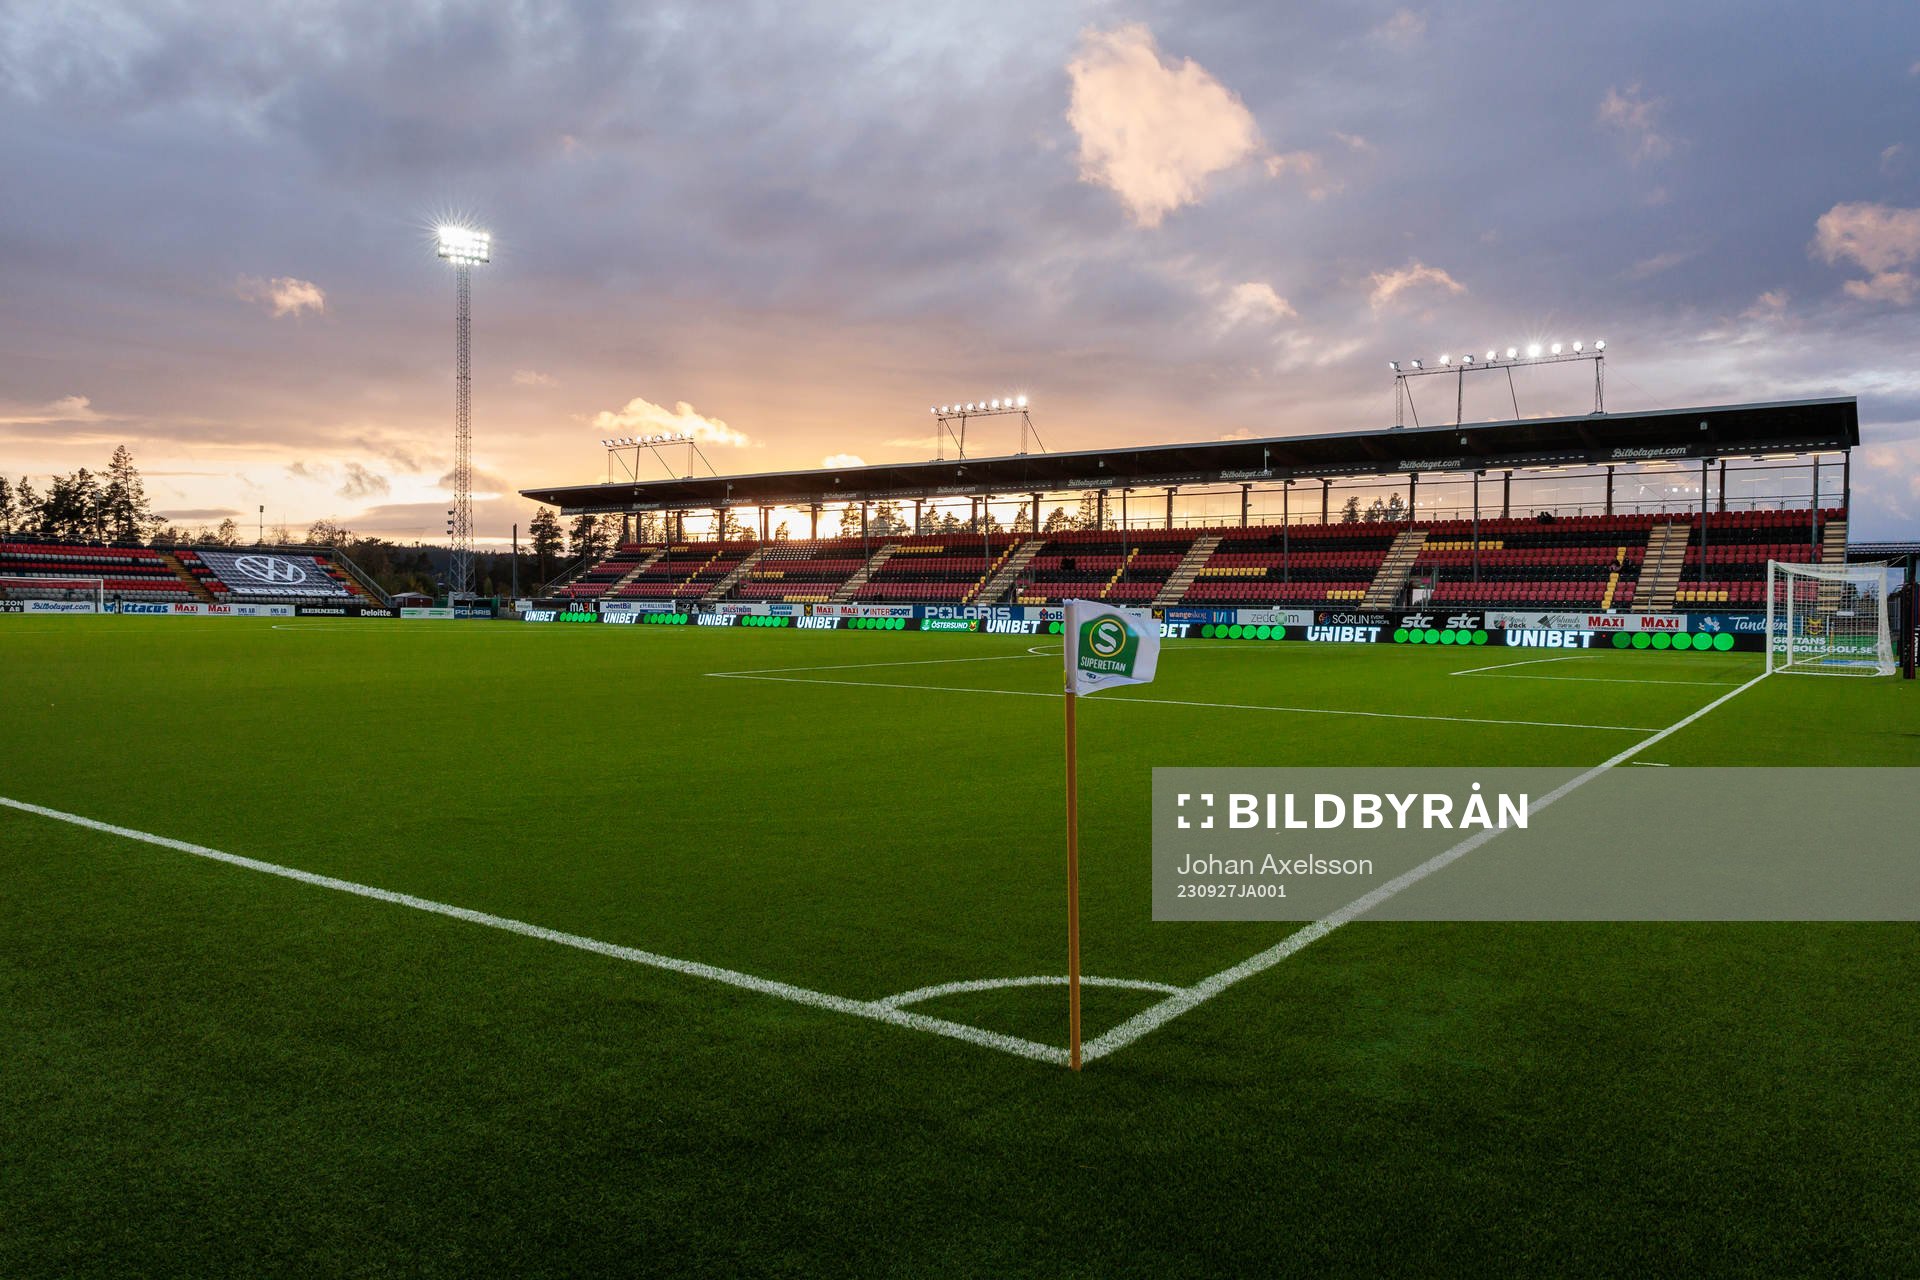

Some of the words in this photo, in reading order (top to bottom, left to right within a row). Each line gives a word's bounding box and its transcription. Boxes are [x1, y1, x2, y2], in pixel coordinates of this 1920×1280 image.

[1612, 447, 1687, 458] Bilbolaget.com
[1398, 460, 1461, 470] Bilbolaget.com
[32, 602, 91, 611] Bilbolaget.com
[869, 608, 911, 616] INTERSPORT
[525, 611, 556, 621] UNIBET
[603, 612, 639, 624] UNIBET
[925, 606, 1011, 620] POLARIS
[1332, 612, 1369, 624] SÖRLIN
[697, 614, 737, 626] UNIBET
[797, 616, 840, 629] UNIBET
[931, 620, 968, 630] ÖSTERSUND
[986, 619, 1041, 634] UNIBET
[1306, 625, 1381, 643] UNIBET
[1506, 630, 1595, 648] UNIBET
[1772, 645, 1873, 654] FOBOLLSGOLF.SE
[1080, 656, 1126, 672] SUPERETTAN
